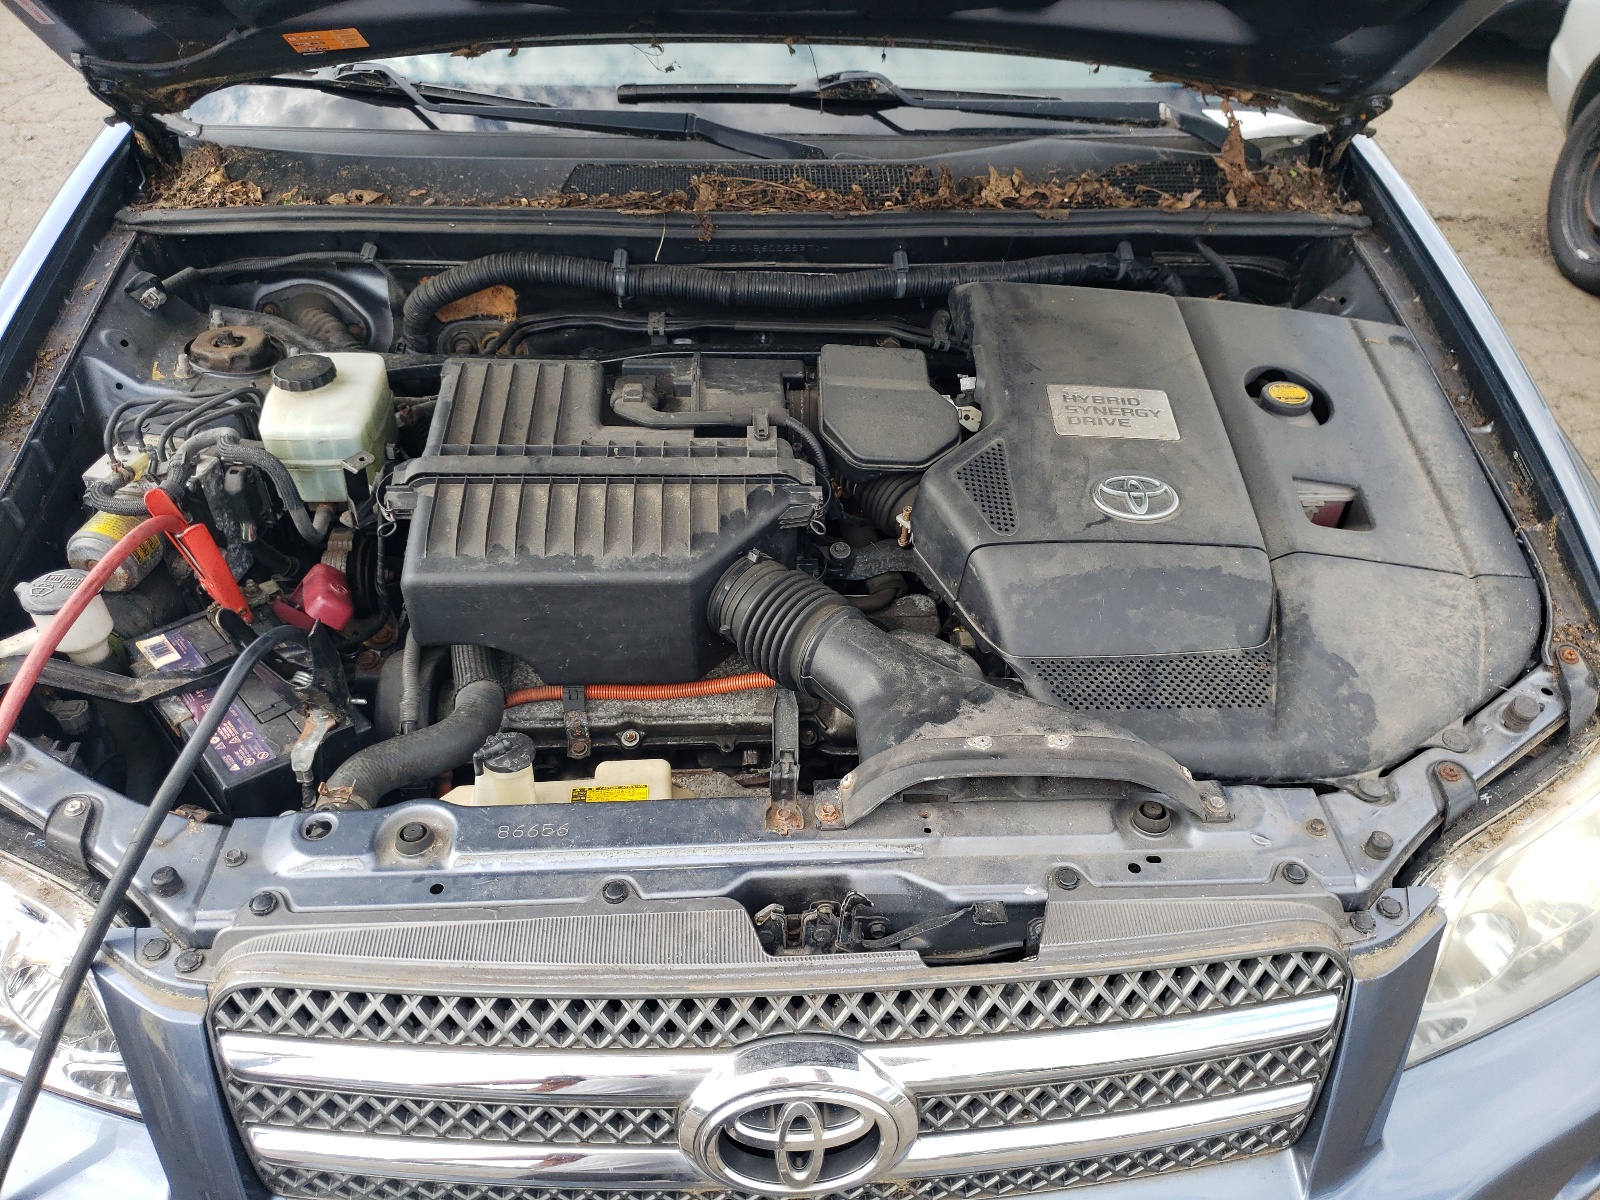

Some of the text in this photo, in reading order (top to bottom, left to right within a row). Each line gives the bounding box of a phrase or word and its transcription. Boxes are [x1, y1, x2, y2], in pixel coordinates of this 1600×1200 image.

[1062, 394, 1141, 406] HYBRID
[1064, 405, 1162, 418] SYNERGY
[1067, 416, 1132, 428] DRIVE
[497, 823, 570, 839] 86656
